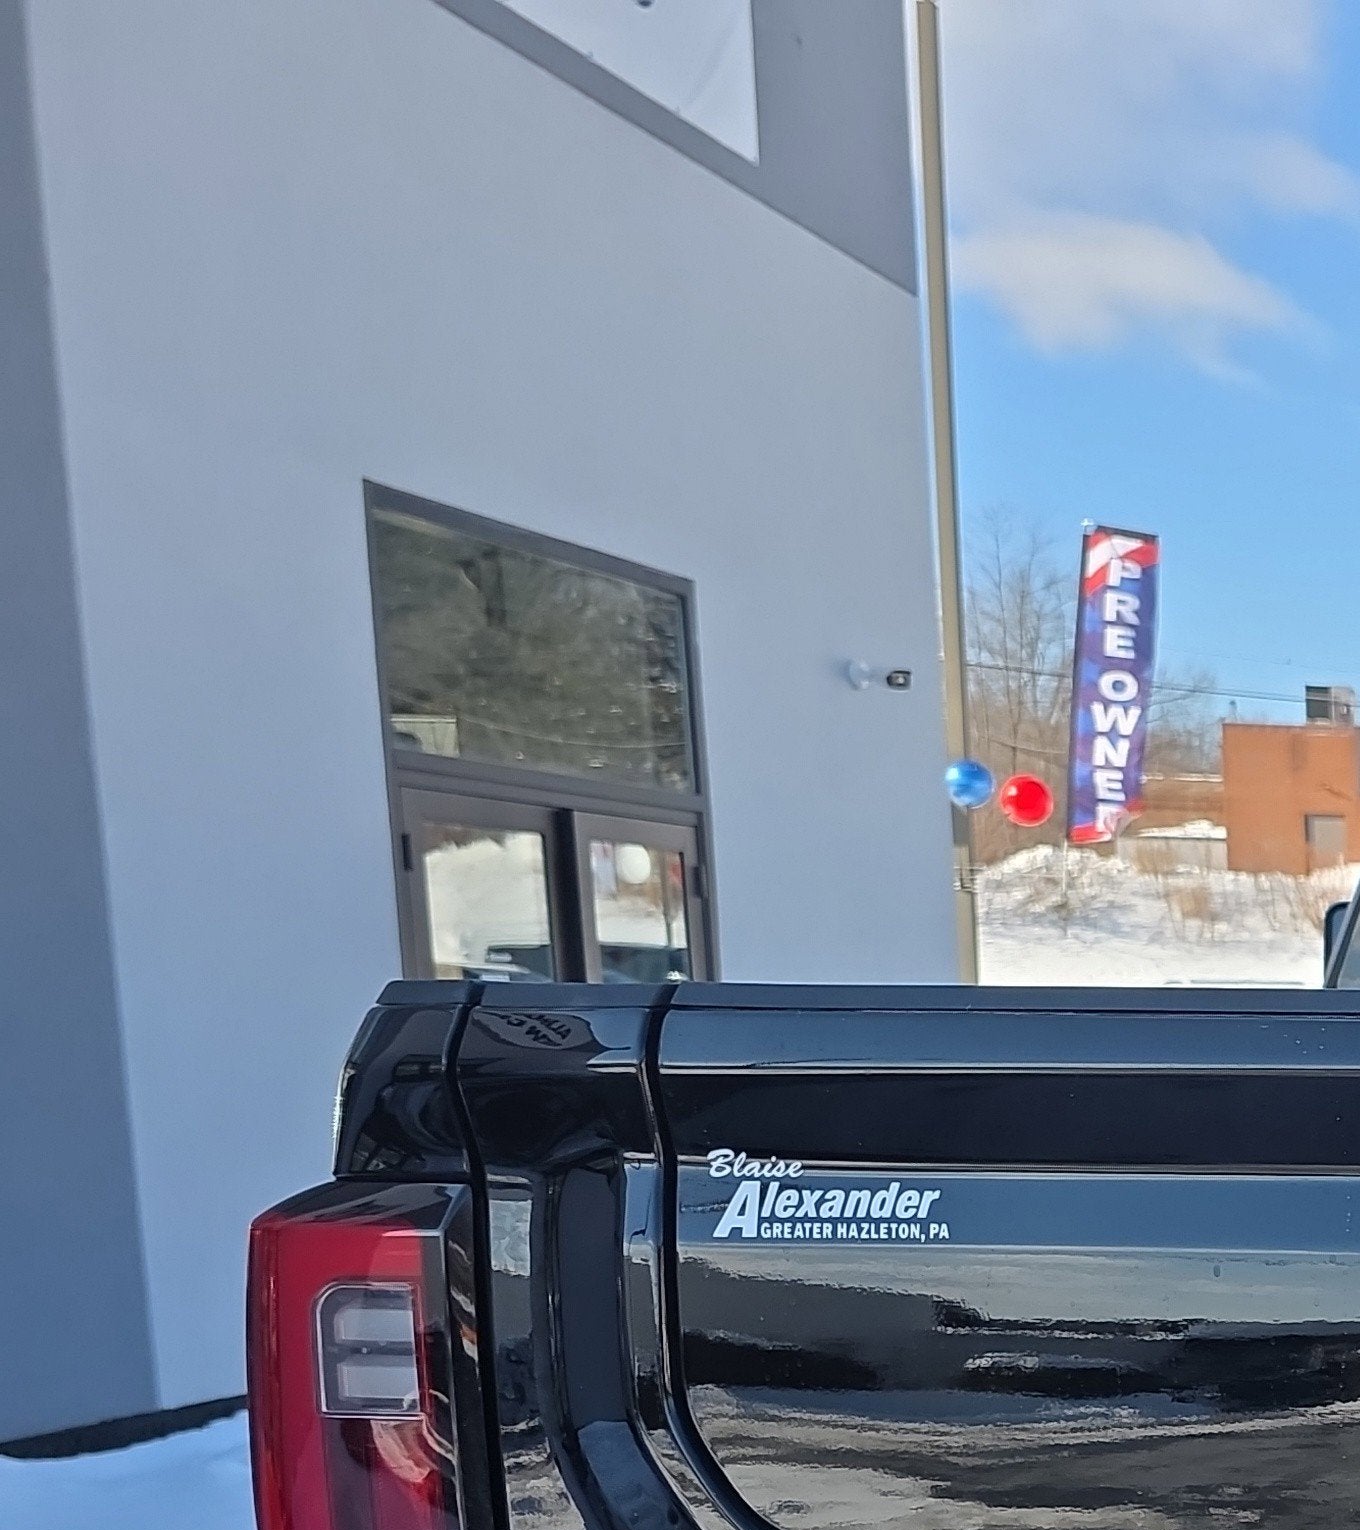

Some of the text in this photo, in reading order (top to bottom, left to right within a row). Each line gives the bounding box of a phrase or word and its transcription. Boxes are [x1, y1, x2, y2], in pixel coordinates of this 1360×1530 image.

[1104, 558, 1141, 660] PRE
[706, 1148, 804, 1179] Blaise
[712, 1180, 941, 1238] Alexander
[760, 1221, 950, 1243] GREATER HAZLETON, PA
